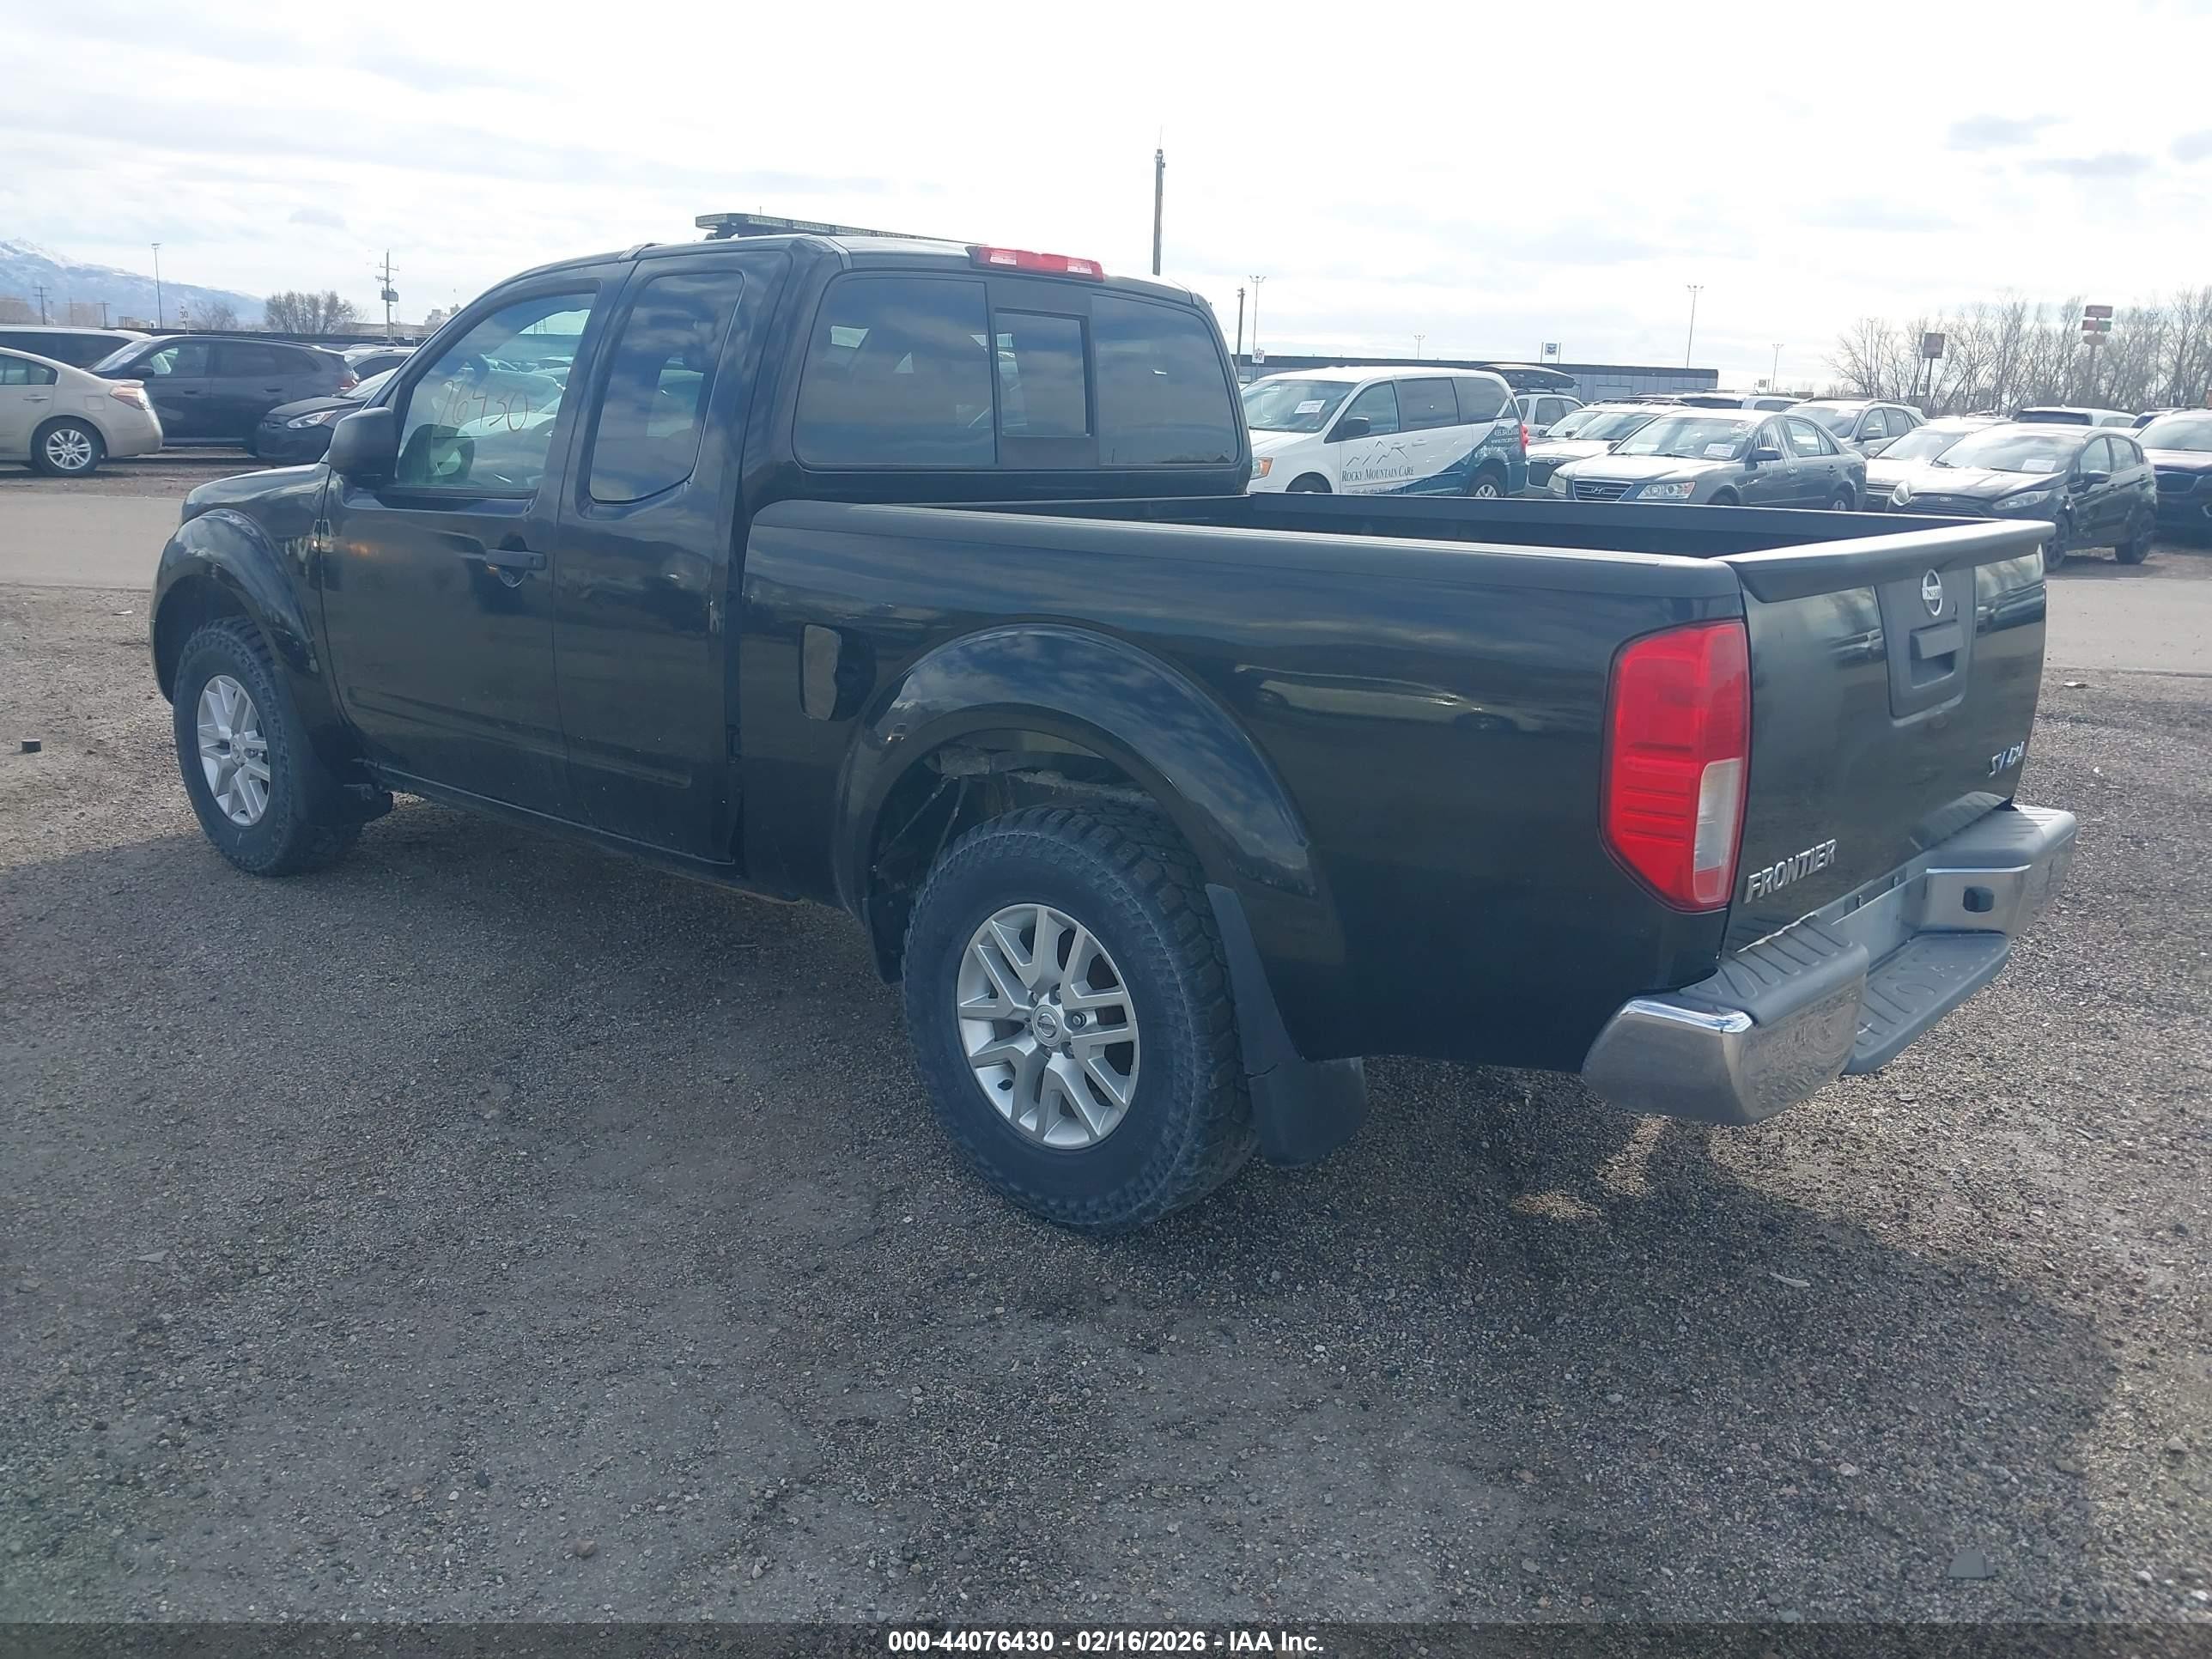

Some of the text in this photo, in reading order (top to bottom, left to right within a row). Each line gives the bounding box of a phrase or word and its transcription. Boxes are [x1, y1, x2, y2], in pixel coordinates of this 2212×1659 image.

[1342, 465, 1415, 482] ROCKY MOUNTAIN CARE
[1744, 838, 1836, 904] FRONTIER
